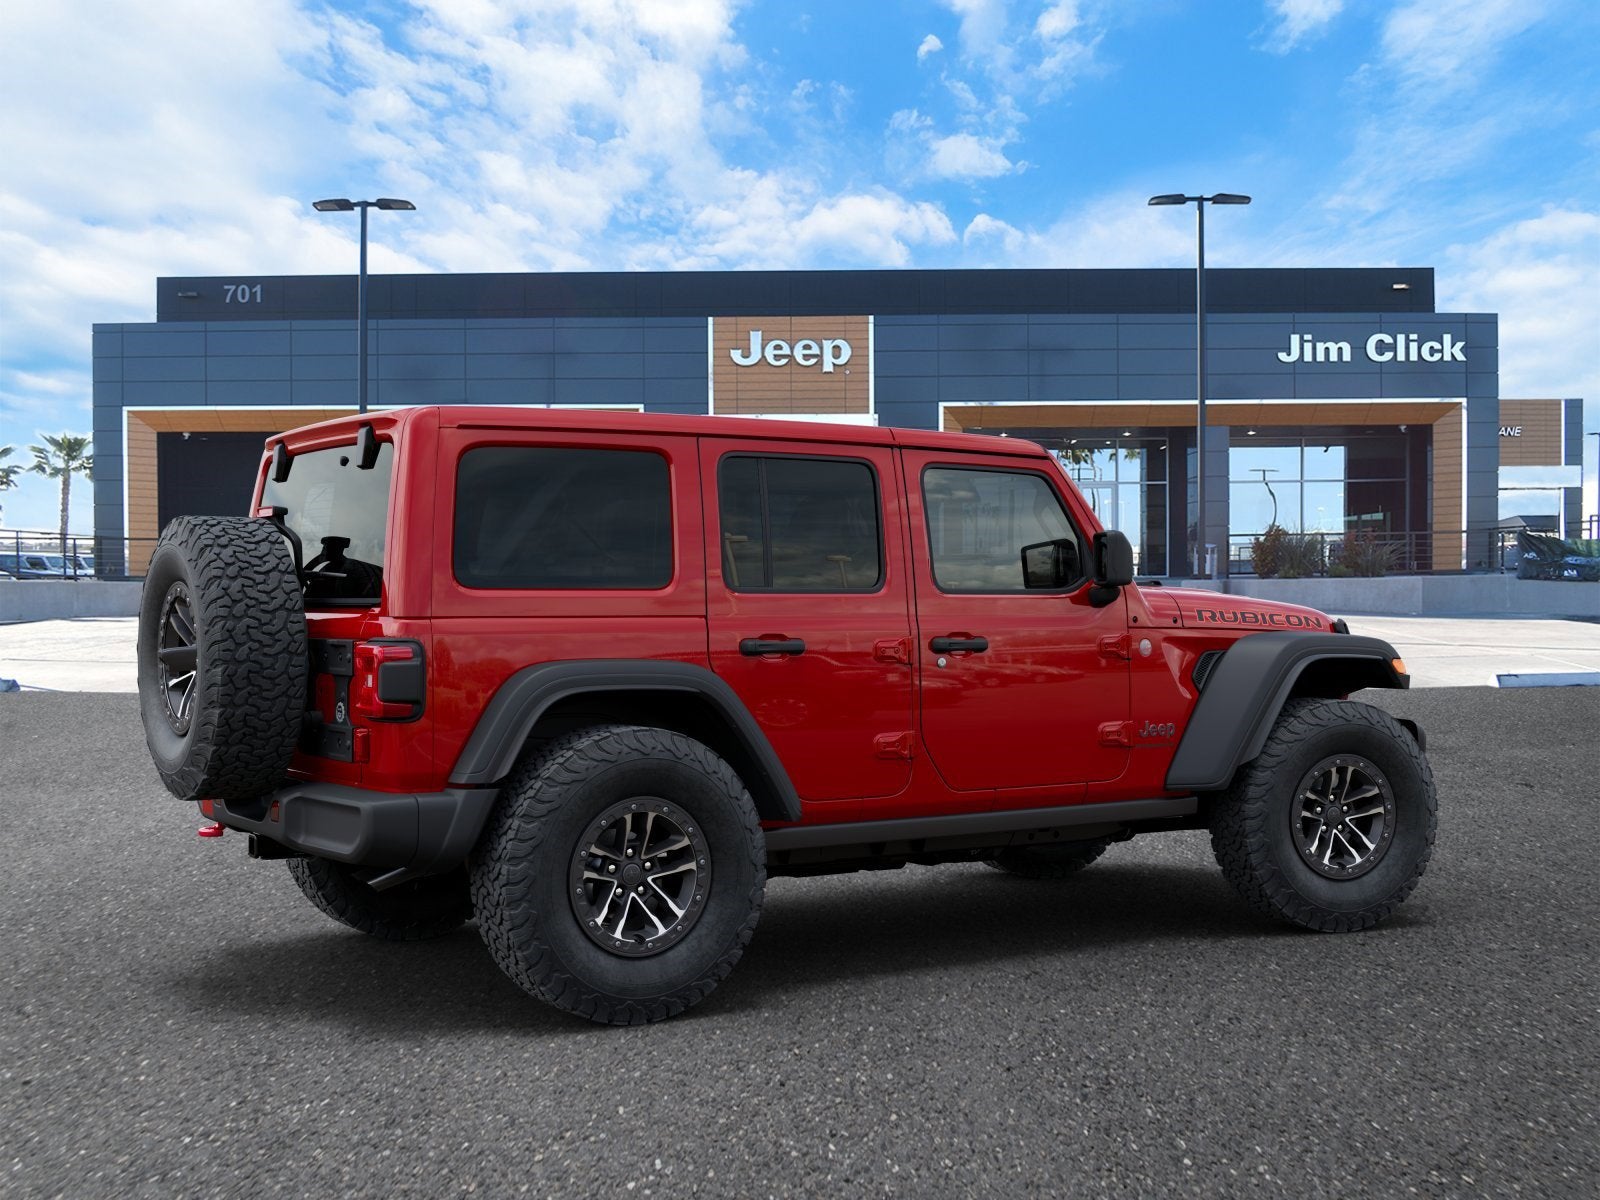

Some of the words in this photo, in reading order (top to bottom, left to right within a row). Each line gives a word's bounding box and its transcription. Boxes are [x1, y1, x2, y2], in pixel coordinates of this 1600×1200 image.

[223, 284, 261, 303] 701
[730, 330, 852, 373] Jeep
[1277, 333, 1351, 363] Jim
[1366, 333, 1467, 362] Click
[1195, 608, 1323, 629] RUBICON
[1139, 720, 1175, 739] Jeep
